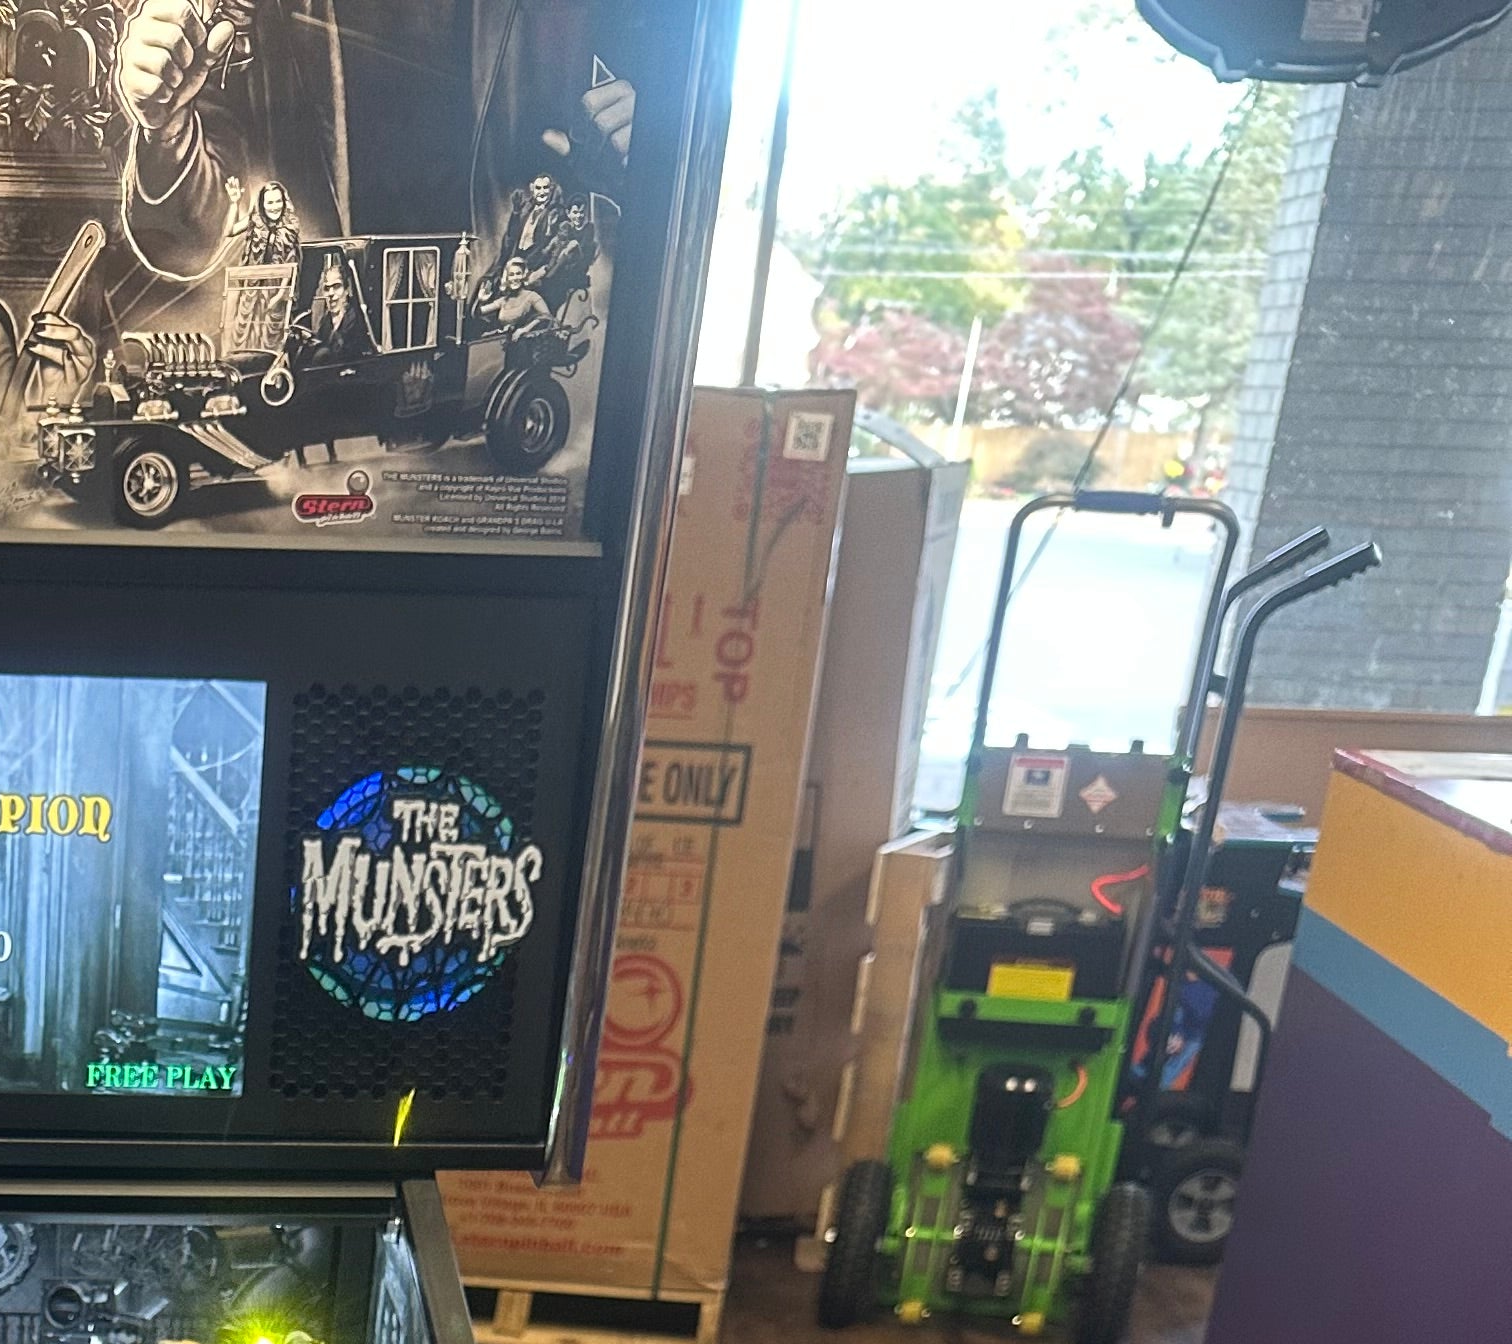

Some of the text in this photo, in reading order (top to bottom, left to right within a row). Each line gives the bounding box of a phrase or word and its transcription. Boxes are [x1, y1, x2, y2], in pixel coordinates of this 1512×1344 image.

[301, 498, 366, 516] Stern
[662, 762, 737, 809] ONLY
[393, 800, 459, 843] THE
[300, 837, 543, 966] MUNSTERS
[86, 1063, 237, 1091] FREE PLAY
